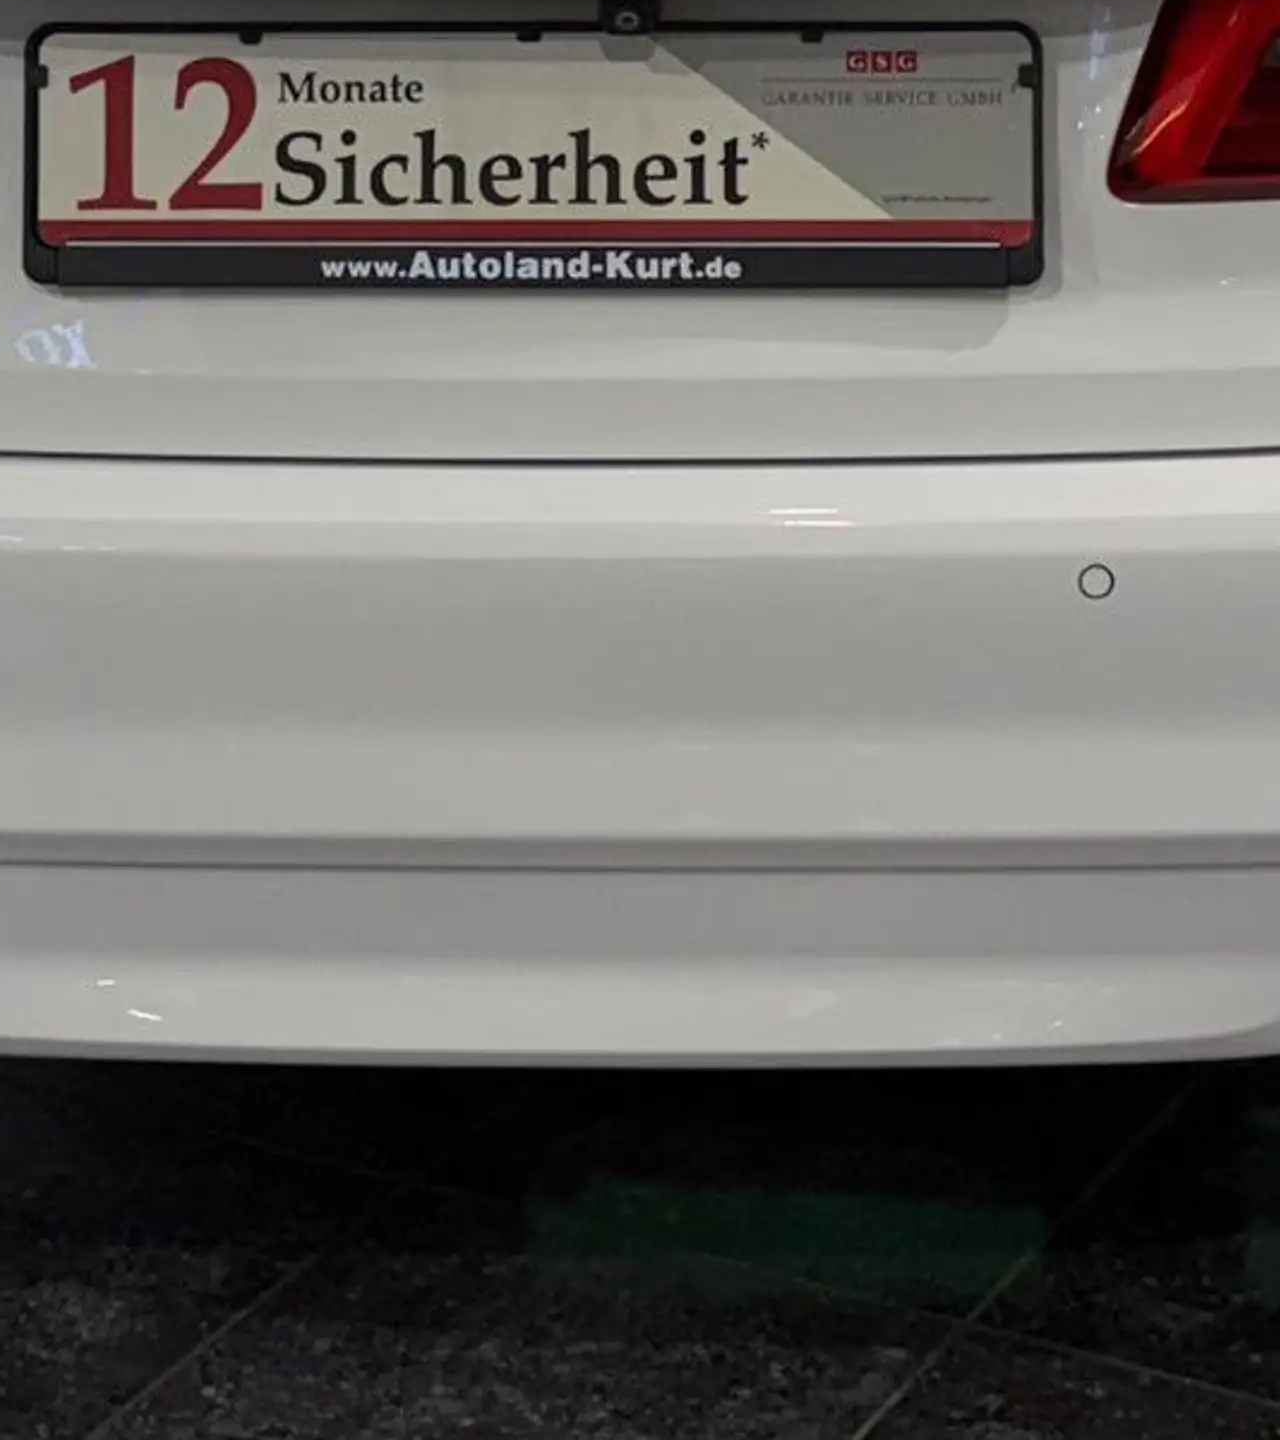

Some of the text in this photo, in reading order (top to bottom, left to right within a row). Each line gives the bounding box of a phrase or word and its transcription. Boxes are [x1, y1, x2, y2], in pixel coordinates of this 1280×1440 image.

[847, 51, 918, 73] GSG
[277, 72, 424, 104] Monate
[762, 89, 855, 107] GARANTIE
[864, 89, 937, 106] SERVICE
[69, 55, 263, 211] 12
[321, 250, 743, 281] www.Autoland-Kurt.de
